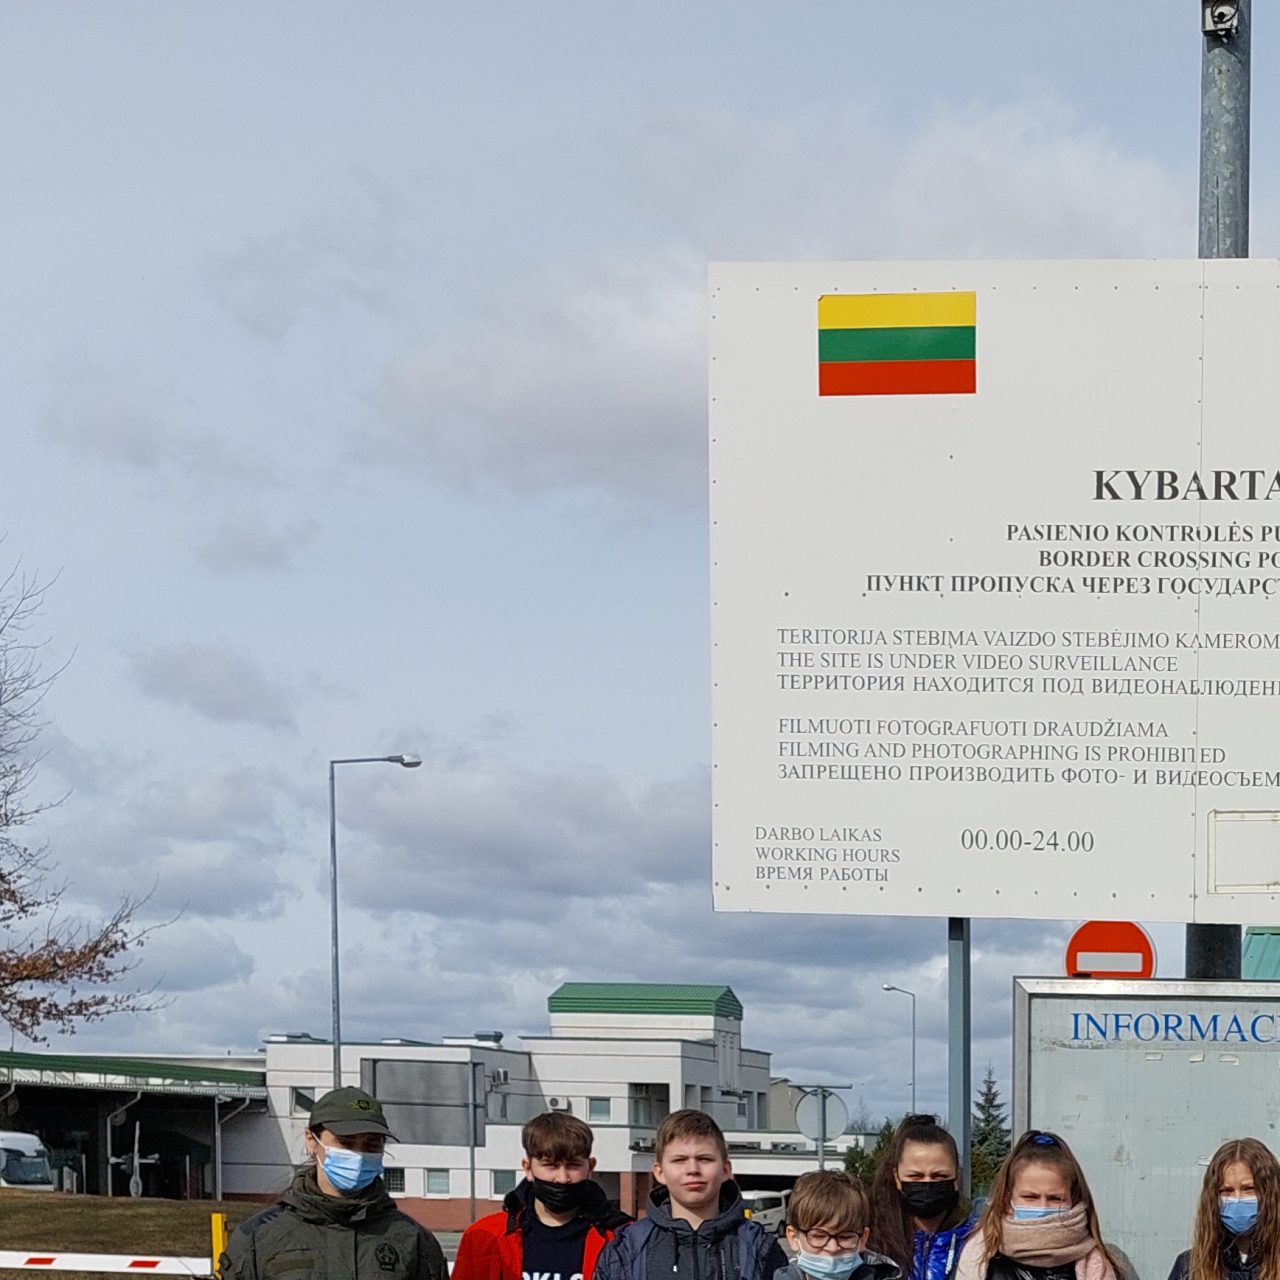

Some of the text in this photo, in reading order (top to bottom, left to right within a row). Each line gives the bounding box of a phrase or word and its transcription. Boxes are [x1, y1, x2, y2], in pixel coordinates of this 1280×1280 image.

[1007, 525, 1109, 541] PASIENIO
[1116, 521, 1253, 542] KONTROLĖS
[1039, 551, 1131, 567] BORDER
[1138, 551, 1251, 568] CROSSING
[866, 575, 944, 592] ПУНКТ
[951, 576, 1076, 593] ПРОПУСКА
[1082, 577, 1150, 594] ЧЕРЕЗ
[777, 629, 887, 645] TERITORIJA
[893, 630, 978, 648] STEBIMA
[983, 631, 1055, 647] VAIZDO
[1062, 629, 1169, 648] STEBĖJIMO
[777, 652, 1178, 671] THE SITE IS UNDER VIDEO SURVEILLANCE
[777, 674, 904, 691] ТЕРРИТОРИЯ
[913, 677, 1033, 694] НАХОДИТСЯ
[1043, 678, 1084, 695] ПОД
[780, 718, 1169, 737] FILMUOTI FOTOGRAFUOTI DRAUDŽIAMA
[779, 742, 1225, 763] FILMING AND PHOTOGRAPHING IS PROHIBITED
[778, 764, 901, 781] ЗАПРЕЩЕНО
[910, 766, 1054, 784] ПРОИЗВОДИТЬ
[1062, 768, 1125, 783] ФОТО-
[1133, 770, 1147, 784] И
[756, 827, 881, 841] DARBO LAIKAS
[961, 829, 1094, 852] 00.00-24.00
[755, 847, 900, 862] WORKING HOURS
[756, 866, 888, 881] ВРЕМЯ РАБОТЫ
